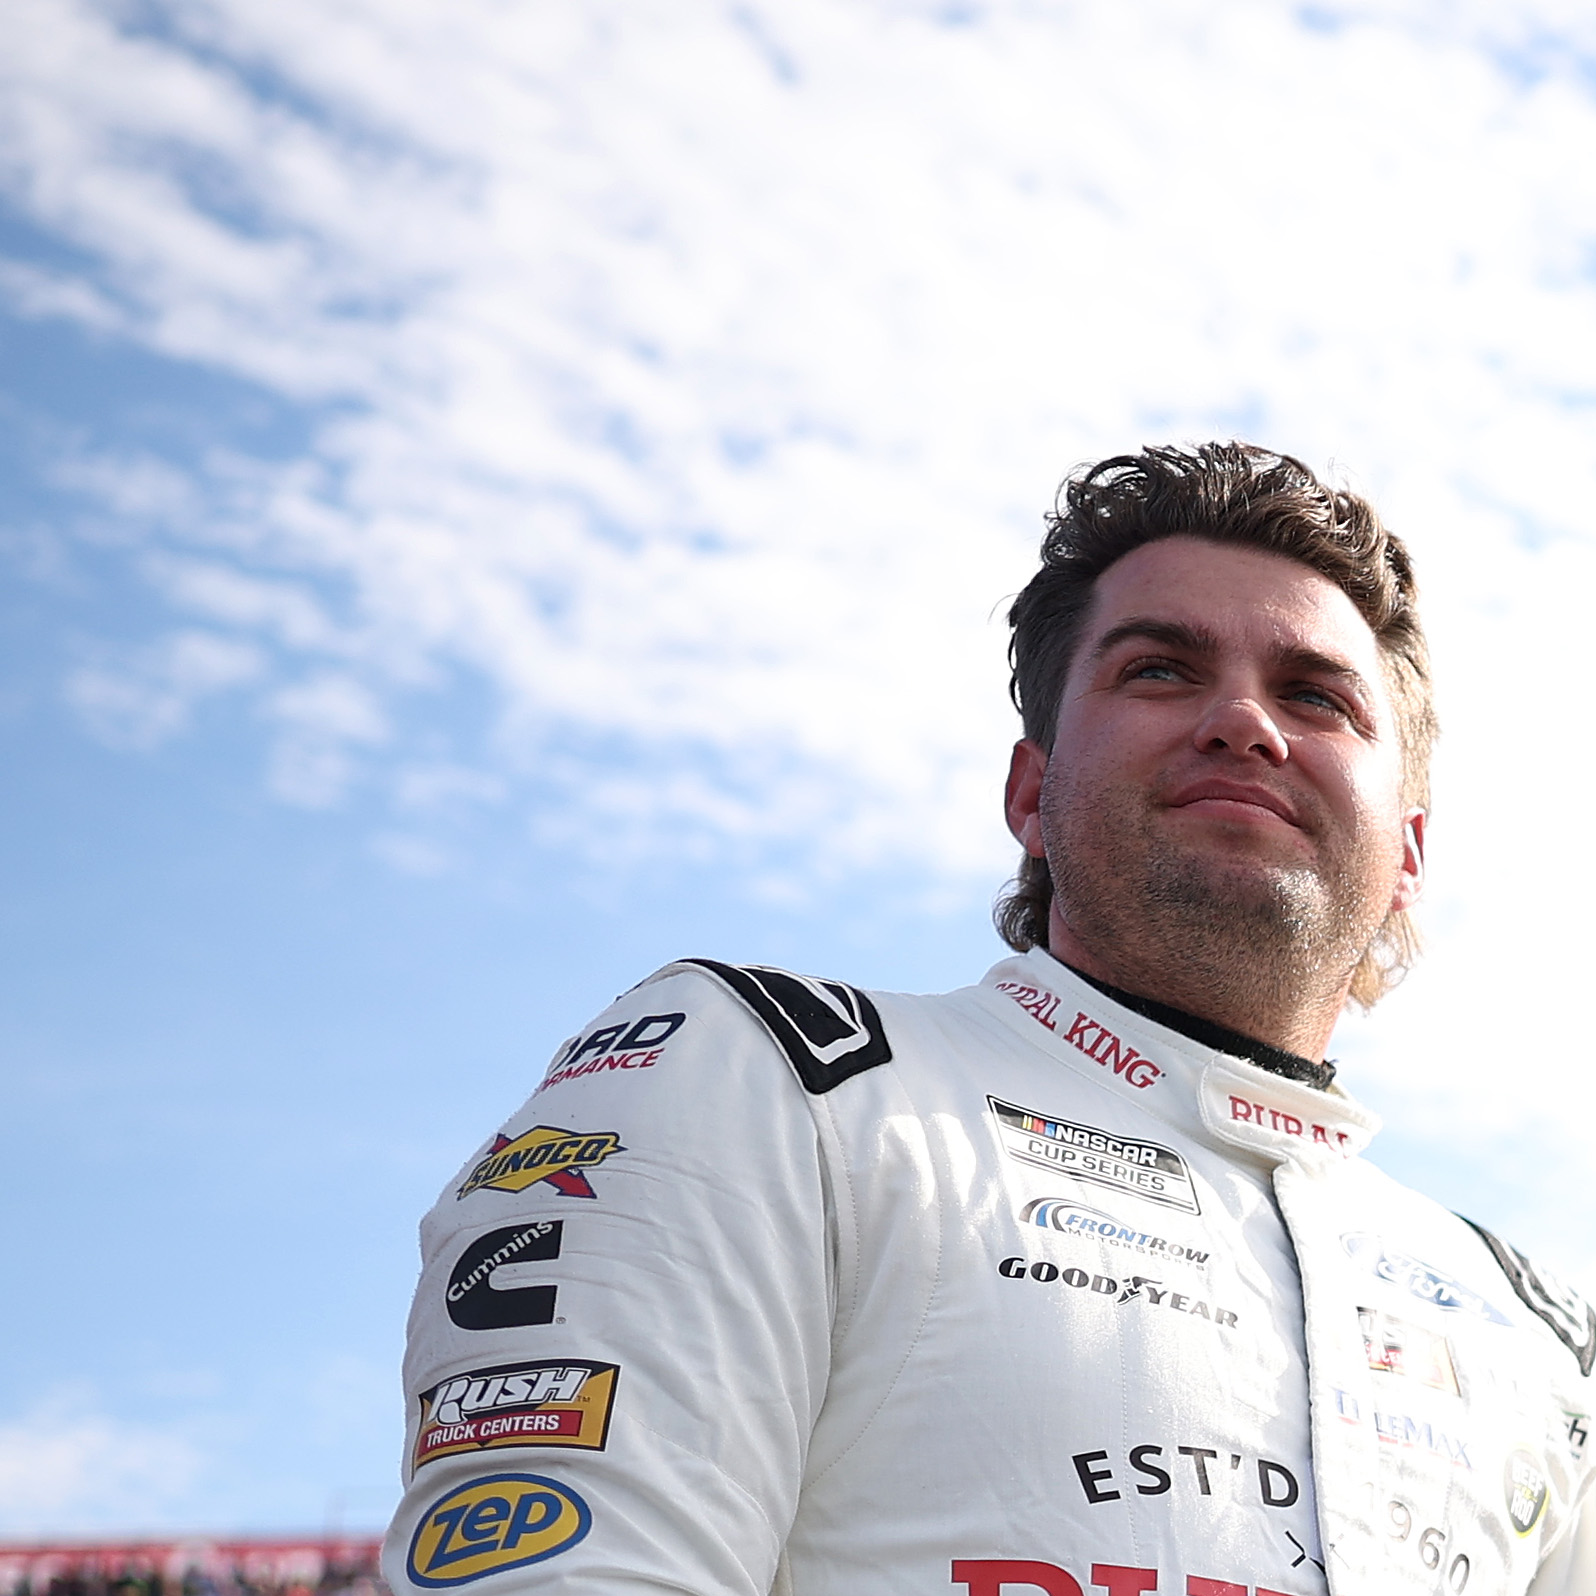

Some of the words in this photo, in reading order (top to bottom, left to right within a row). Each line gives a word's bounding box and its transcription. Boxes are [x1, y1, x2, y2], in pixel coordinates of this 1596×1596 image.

[552, 1012, 686, 1072] RD
[1064, 1012, 1162, 1089] KING
[536, 1047, 665, 1097] RMANCE
[466, 1138, 610, 1187] SUNOCO
[1027, 1139, 1077, 1163] CUP
[1081, 1155, 1166, 1191] SERIES
[1054, 1124, 1158, 1167] NASCAR
[998, 1256, 1240, 1330] GOODYEAR
[429, 1366, 591, 1425] RUSH
[426, 1422, 477, 1447] TRUCK
[479, 1413, 560, 1438] CENTERS
[1072, 1443, 1300, 1508] EST'D
